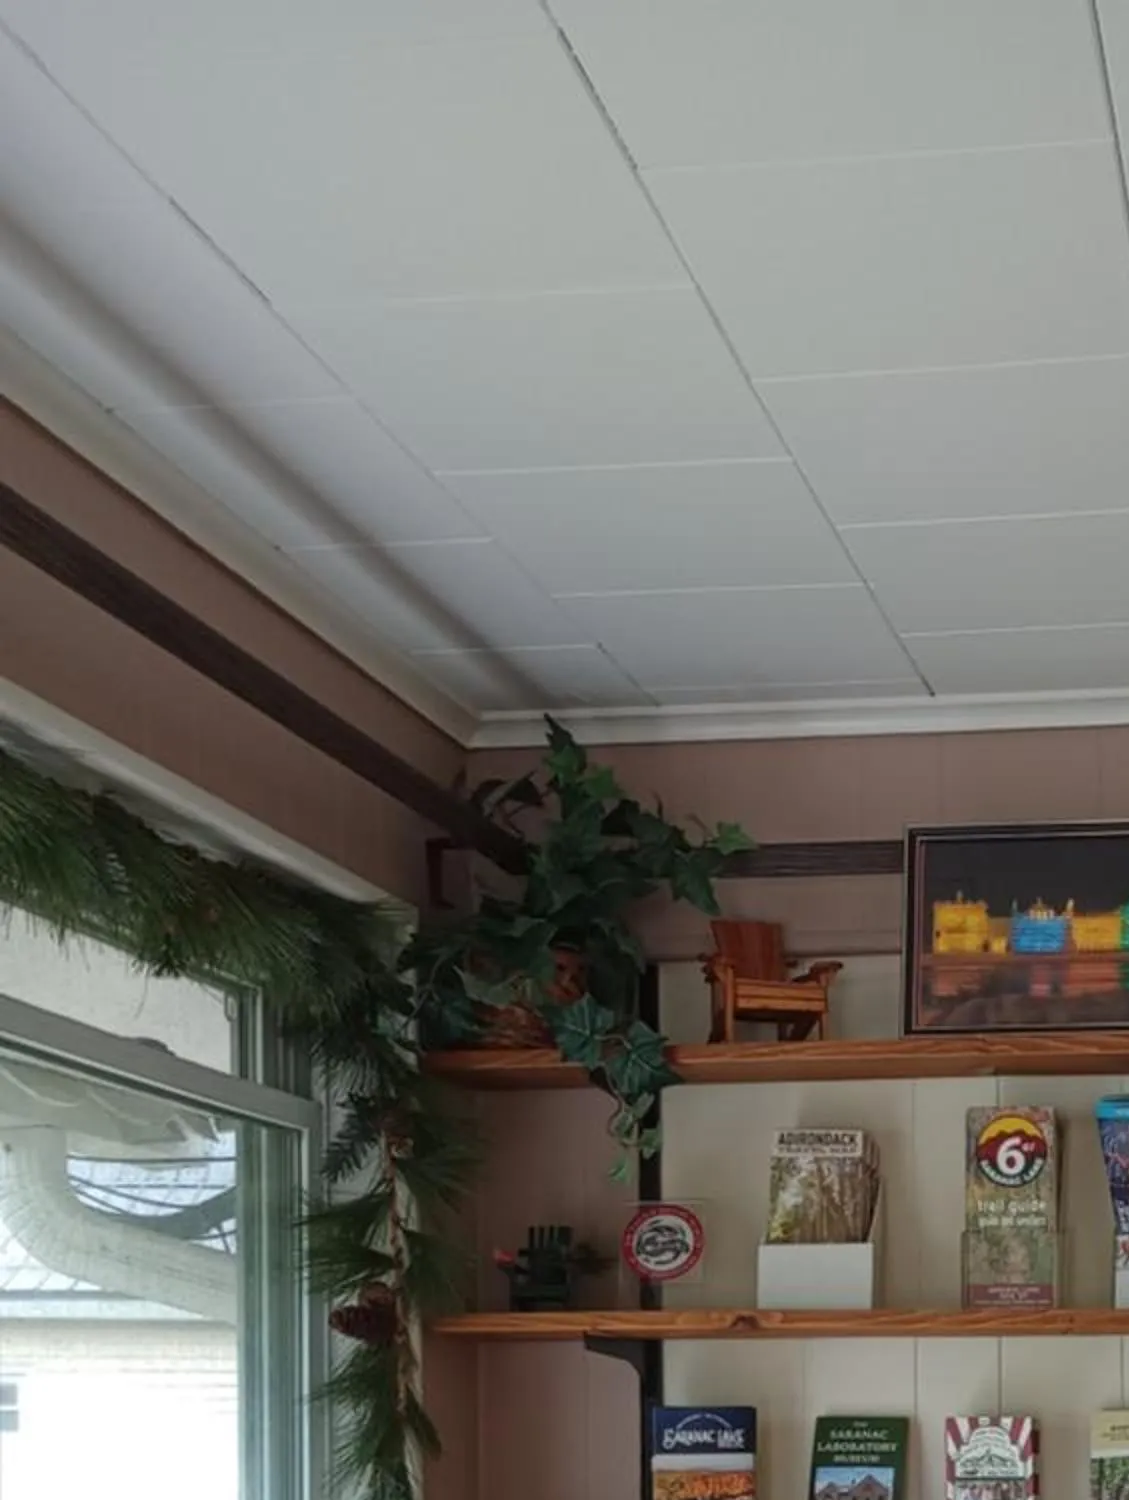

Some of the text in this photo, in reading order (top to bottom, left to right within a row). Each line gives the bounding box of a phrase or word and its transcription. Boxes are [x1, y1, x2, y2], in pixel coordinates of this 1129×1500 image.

[778, 1132, 857, 1145] ADIRONDACK
[829, 1429, 889, 1440] SARANAC
[817, 1442, 897, 1452] LABORATORY
